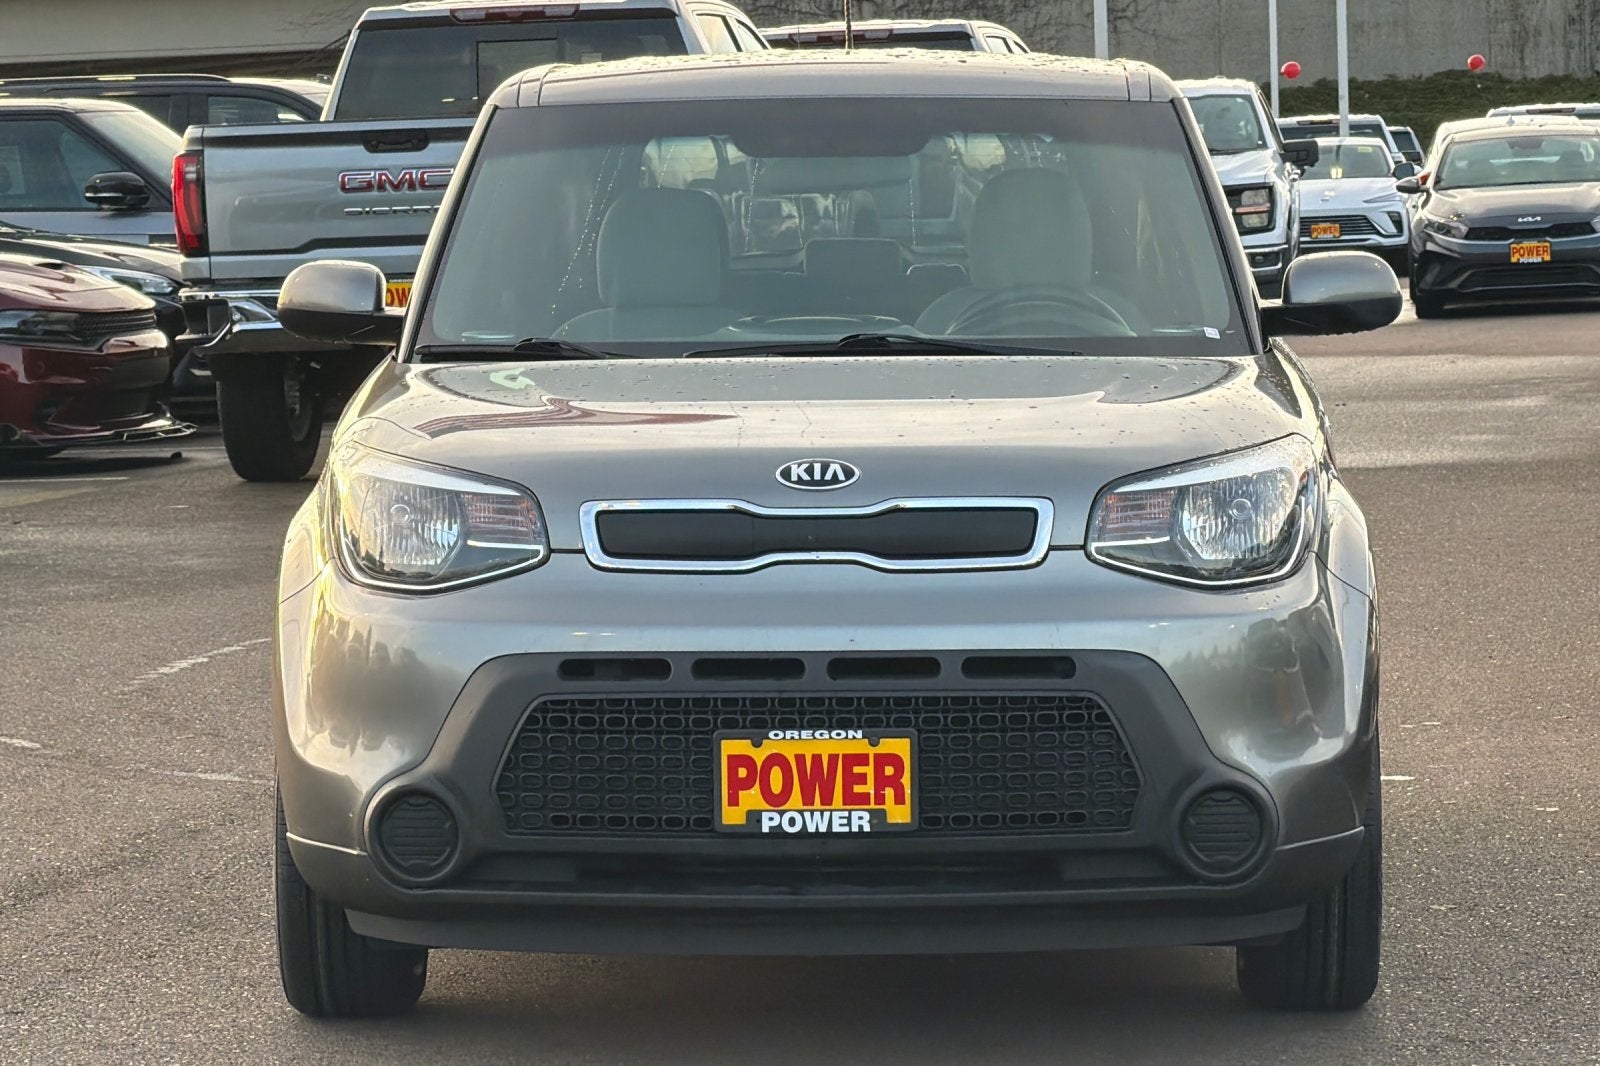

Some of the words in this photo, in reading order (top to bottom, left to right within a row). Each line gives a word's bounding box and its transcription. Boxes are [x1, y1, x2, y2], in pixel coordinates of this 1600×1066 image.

[339, 168, 455, 194] GMC
[1511, 245, 1549, 257] POWER
[790, 462, 846, 481] KIA
[768, 730, 863, 740] OREGON
[726, 752, 906, 808] POWER
[761, 811, 871, 833] POWER
